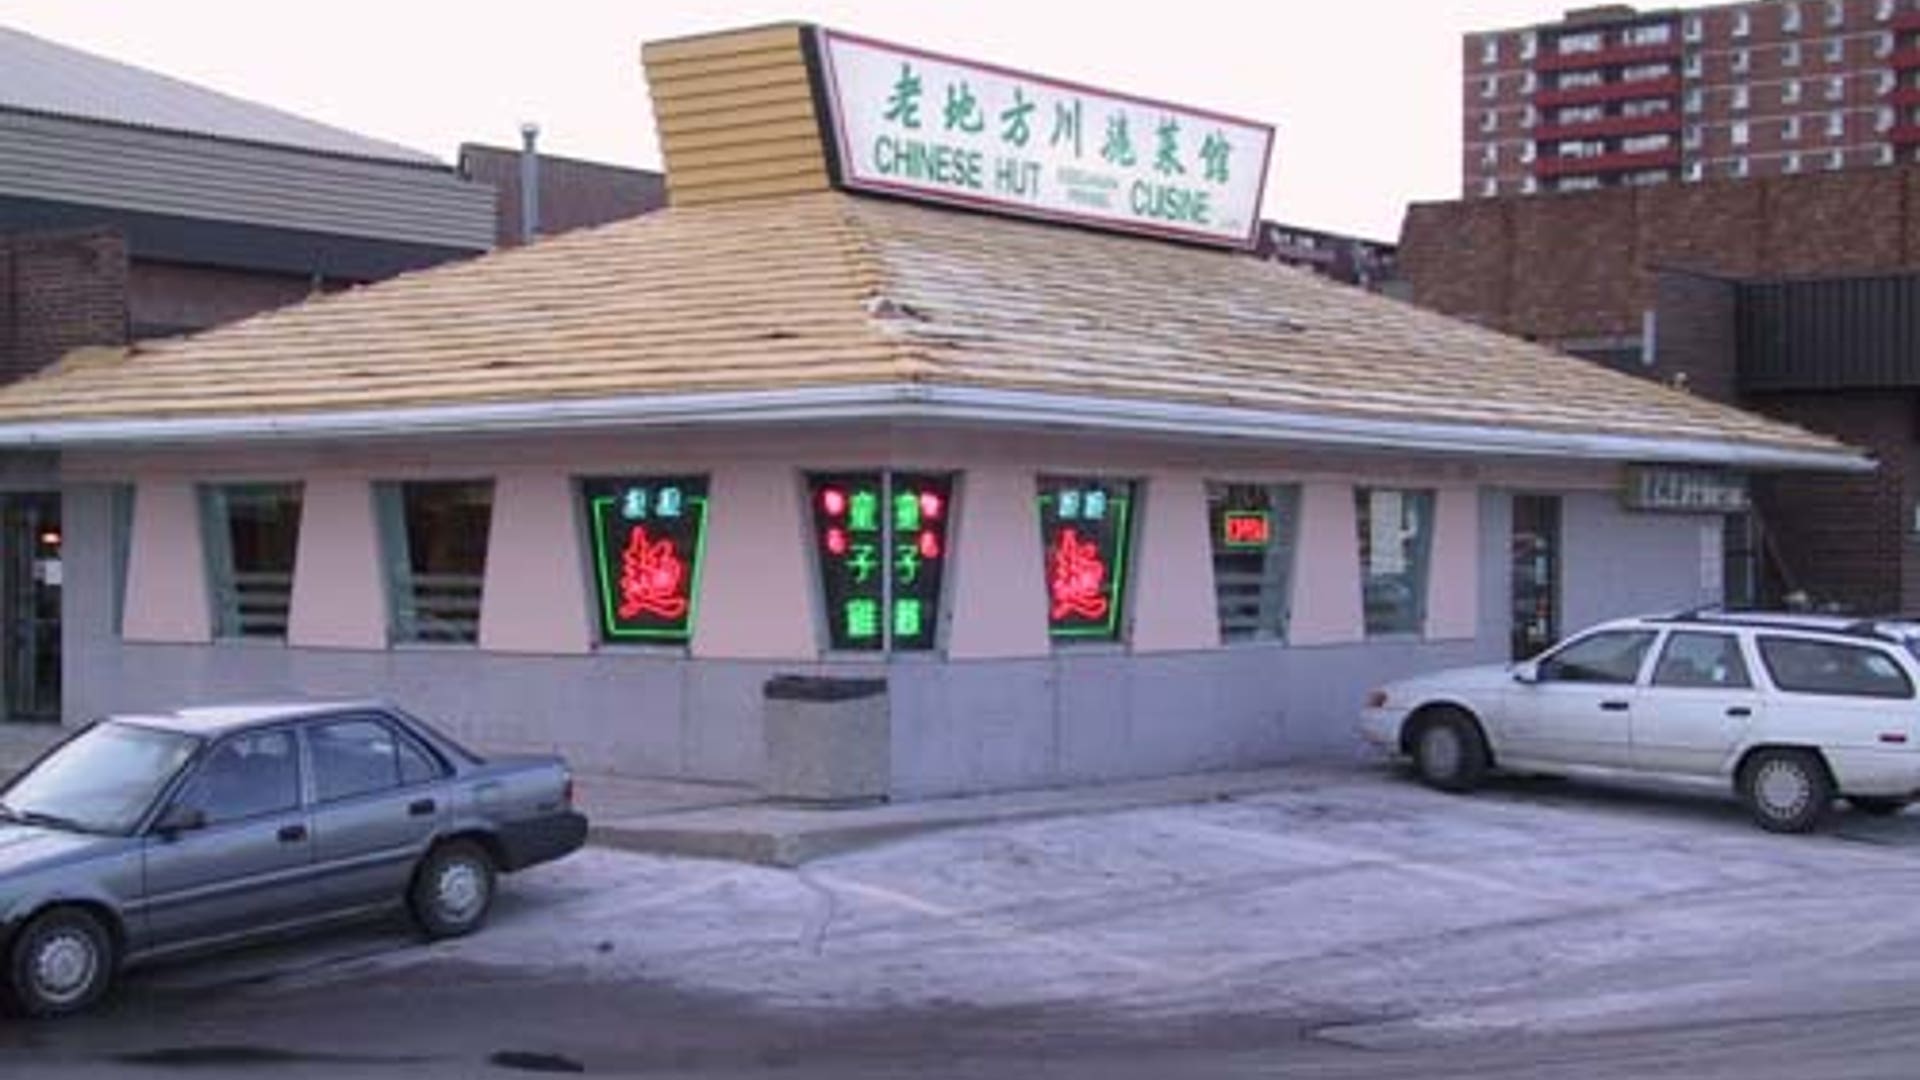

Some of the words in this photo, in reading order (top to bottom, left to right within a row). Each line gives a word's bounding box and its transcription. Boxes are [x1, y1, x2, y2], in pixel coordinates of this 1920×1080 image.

[874, 135, 983, 190] CHINESE
[996, 157, 1041, 197] HUT
[1130, 178, 1209, 223] CUISINE
